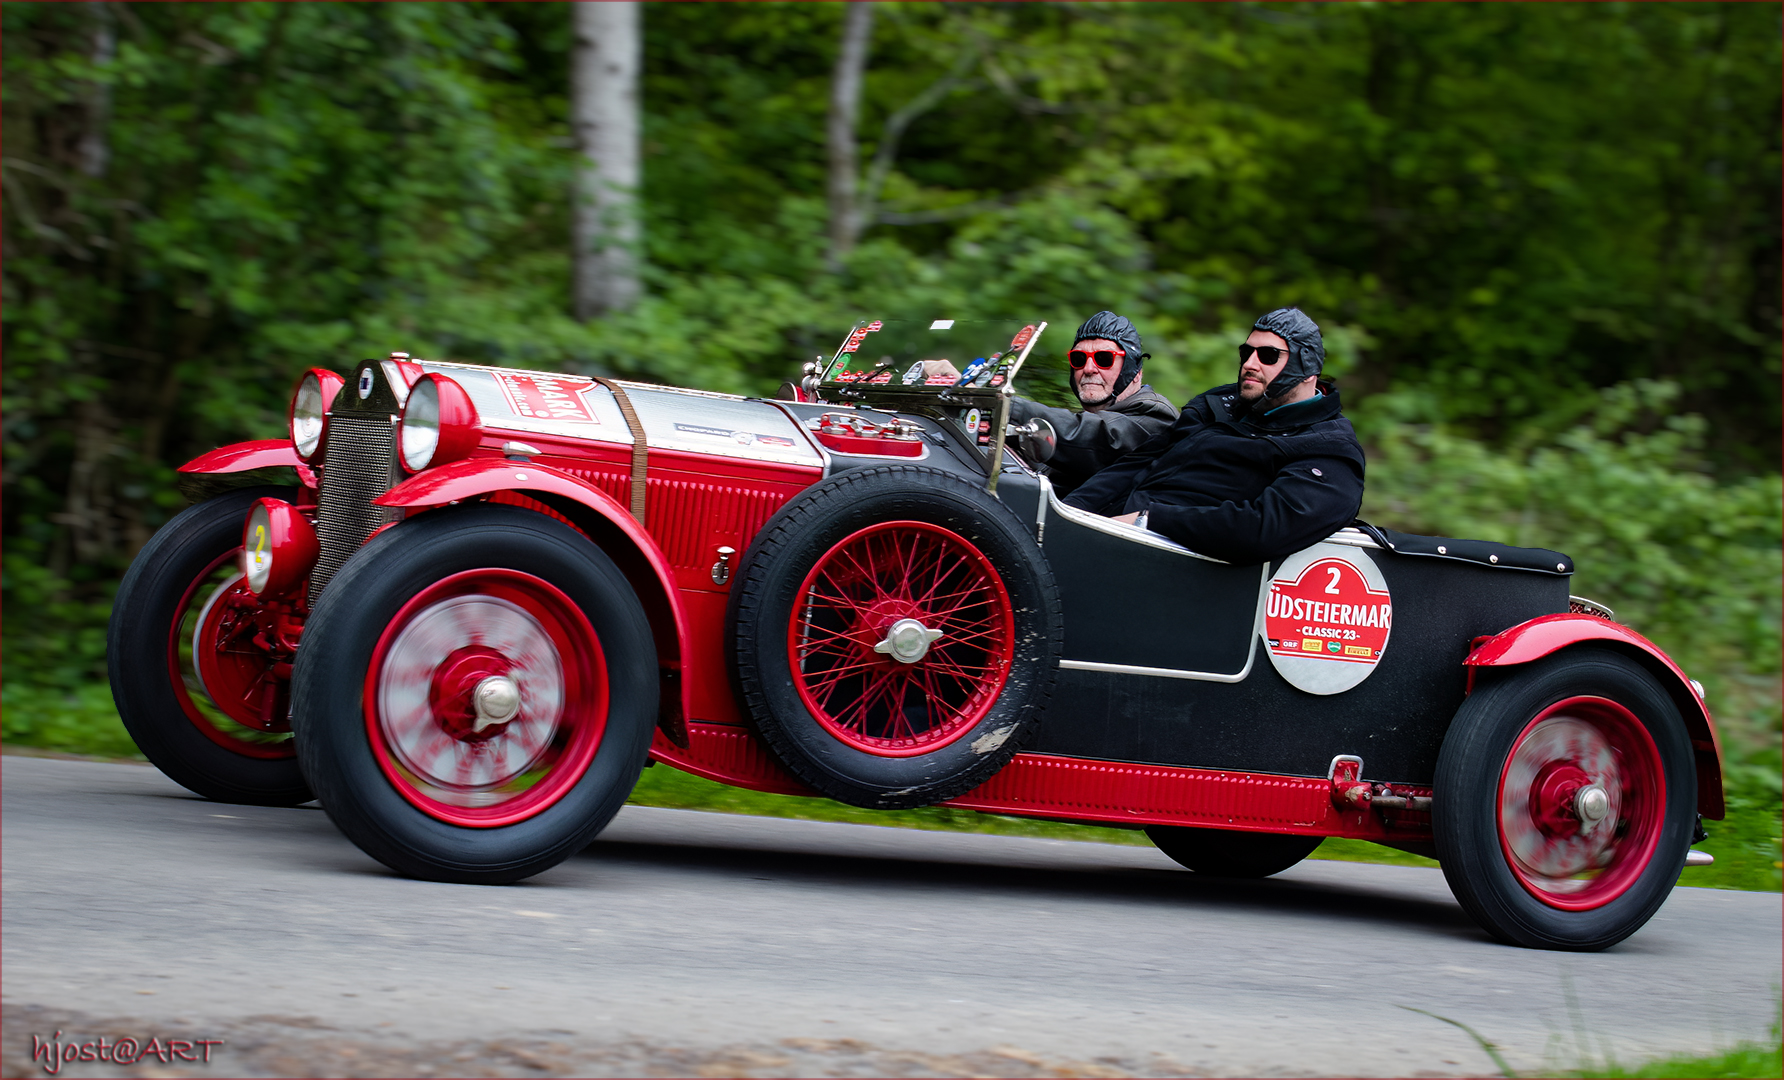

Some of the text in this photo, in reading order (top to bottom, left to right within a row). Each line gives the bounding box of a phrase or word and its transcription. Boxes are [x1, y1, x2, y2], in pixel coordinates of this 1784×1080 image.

[531, 376, 588, 418] MARK
[255, 524, 266, 563] 2
[1324, 567, 1341, 595] 2
[1266, 585, 1391, 629] ÜDSTEIERMAR
